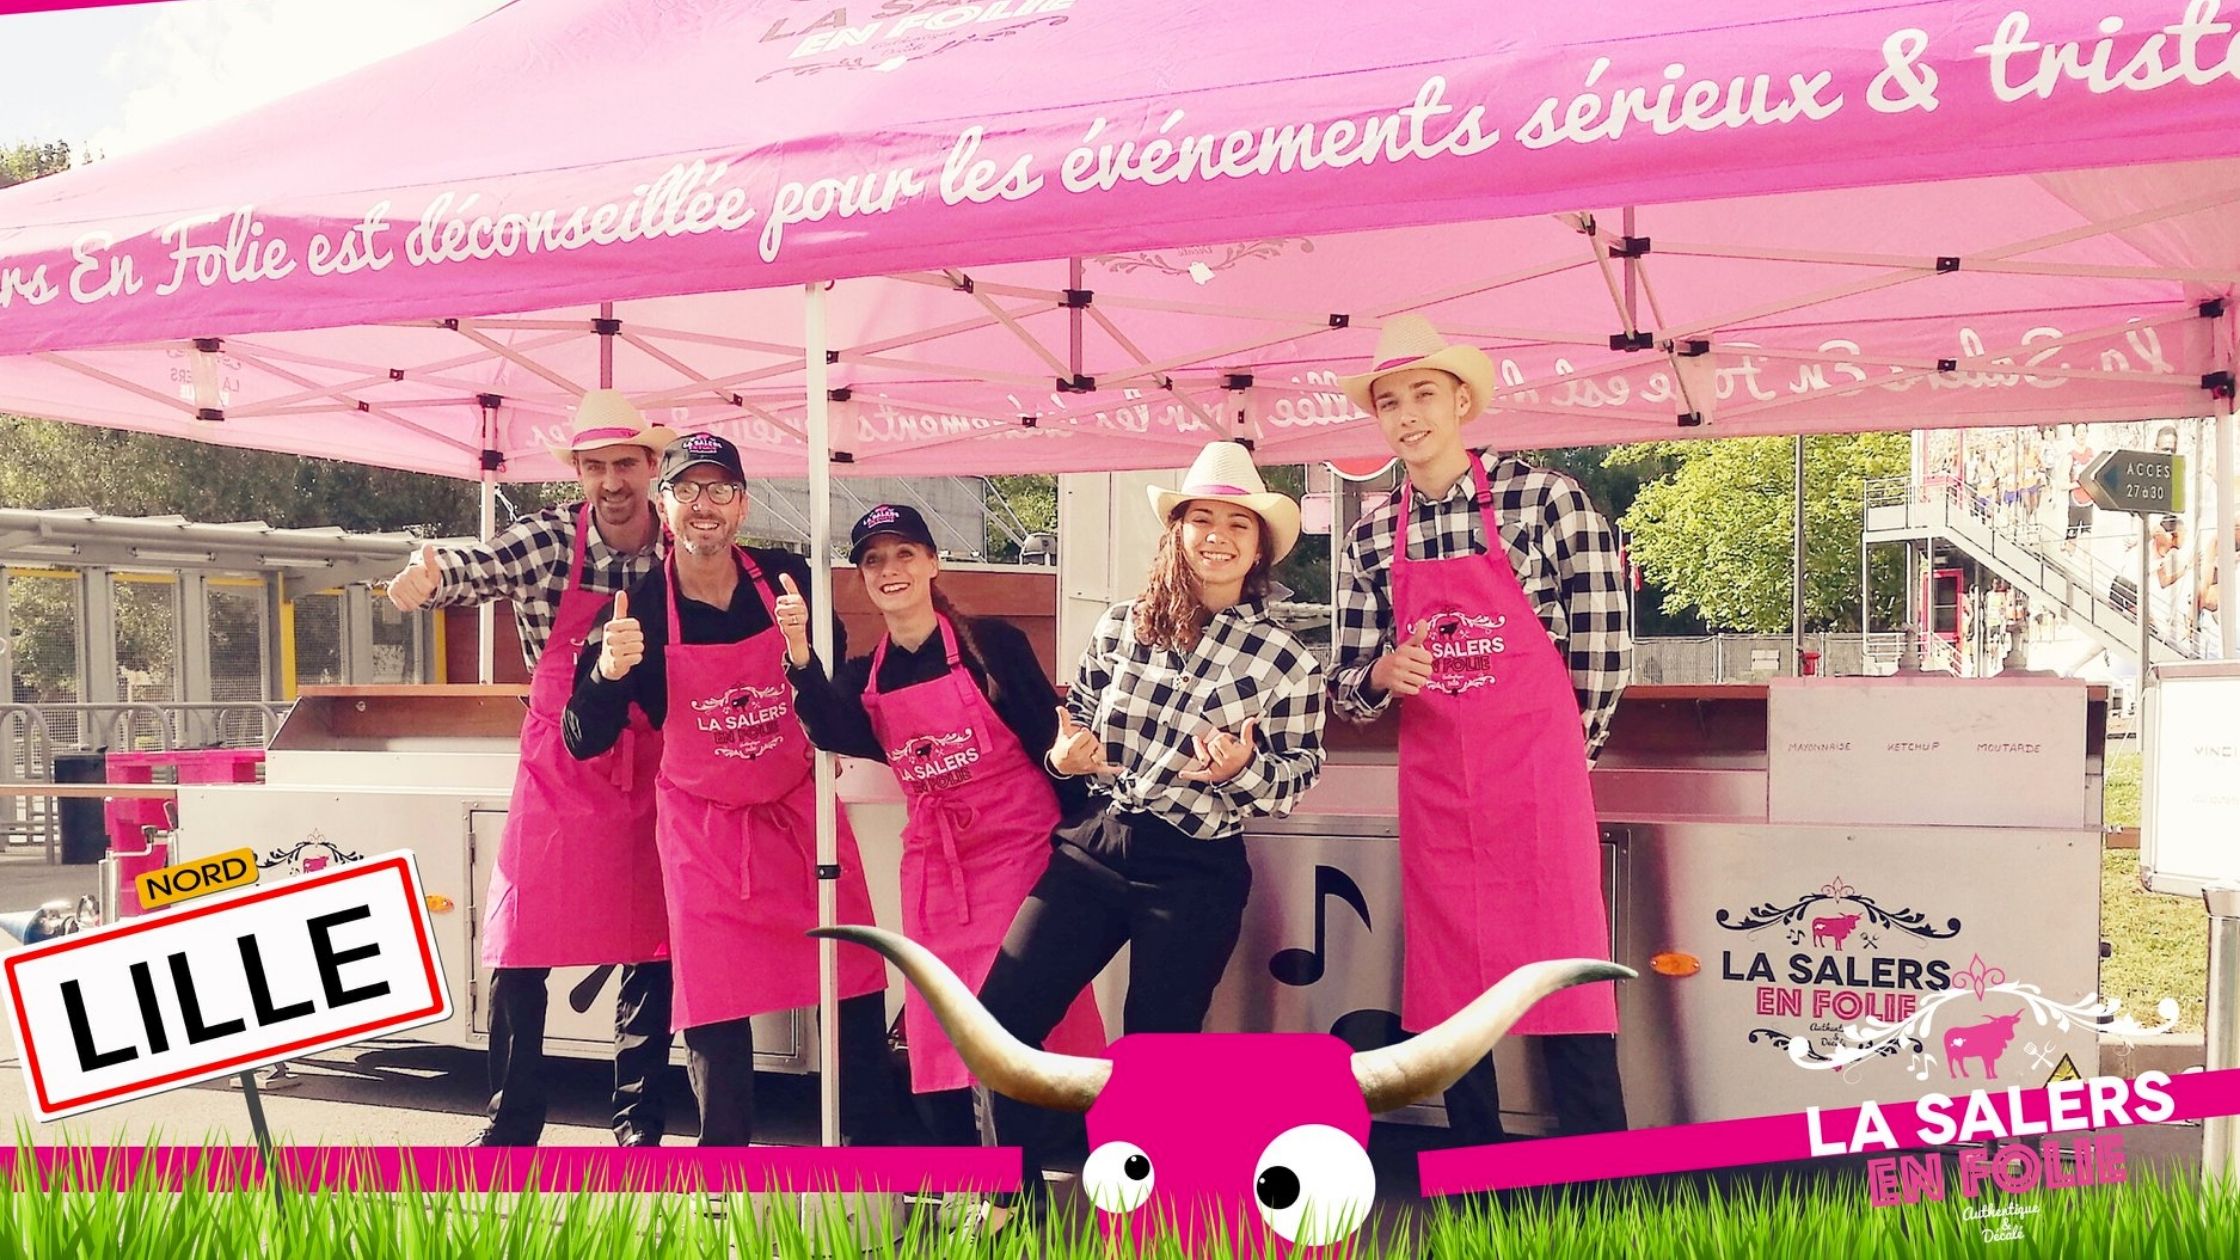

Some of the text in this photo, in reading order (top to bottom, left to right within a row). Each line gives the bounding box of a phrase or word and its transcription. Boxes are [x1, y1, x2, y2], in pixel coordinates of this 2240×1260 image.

[759, 8, 847, 43] LA
[787, 21, 883, 60] EN
[69, 230, 144, 304] En
[155, 203, 297, 296] Folie
[307, 200, 395, 276] est
[405, 159, 757, 267] déconseillée
[759, 166, 926, 263] pour
[939, 125, 1044, 206] les
[1060, 75, 1500, 193] événements
[1515, 56, 1844, 150] sérieux
[1866, 28, 1940, 113] &
[1973, 0, 2240, 102] trist
[2126, 463, 2171, 479] ACCES
[1431, 636, 1505, 658] SALERS
[697, 701, 788, 731] LA SALERS
[914, 747, 980, 779] SALERS
[1887, 741, 1940, 752] KETCHUP
[1976, 743, 2041, 754] MOUTARDE
[1722, 951, 1951, 991] LA SALERS
[1756, 986, 1917, 1023] EN FOLIE
